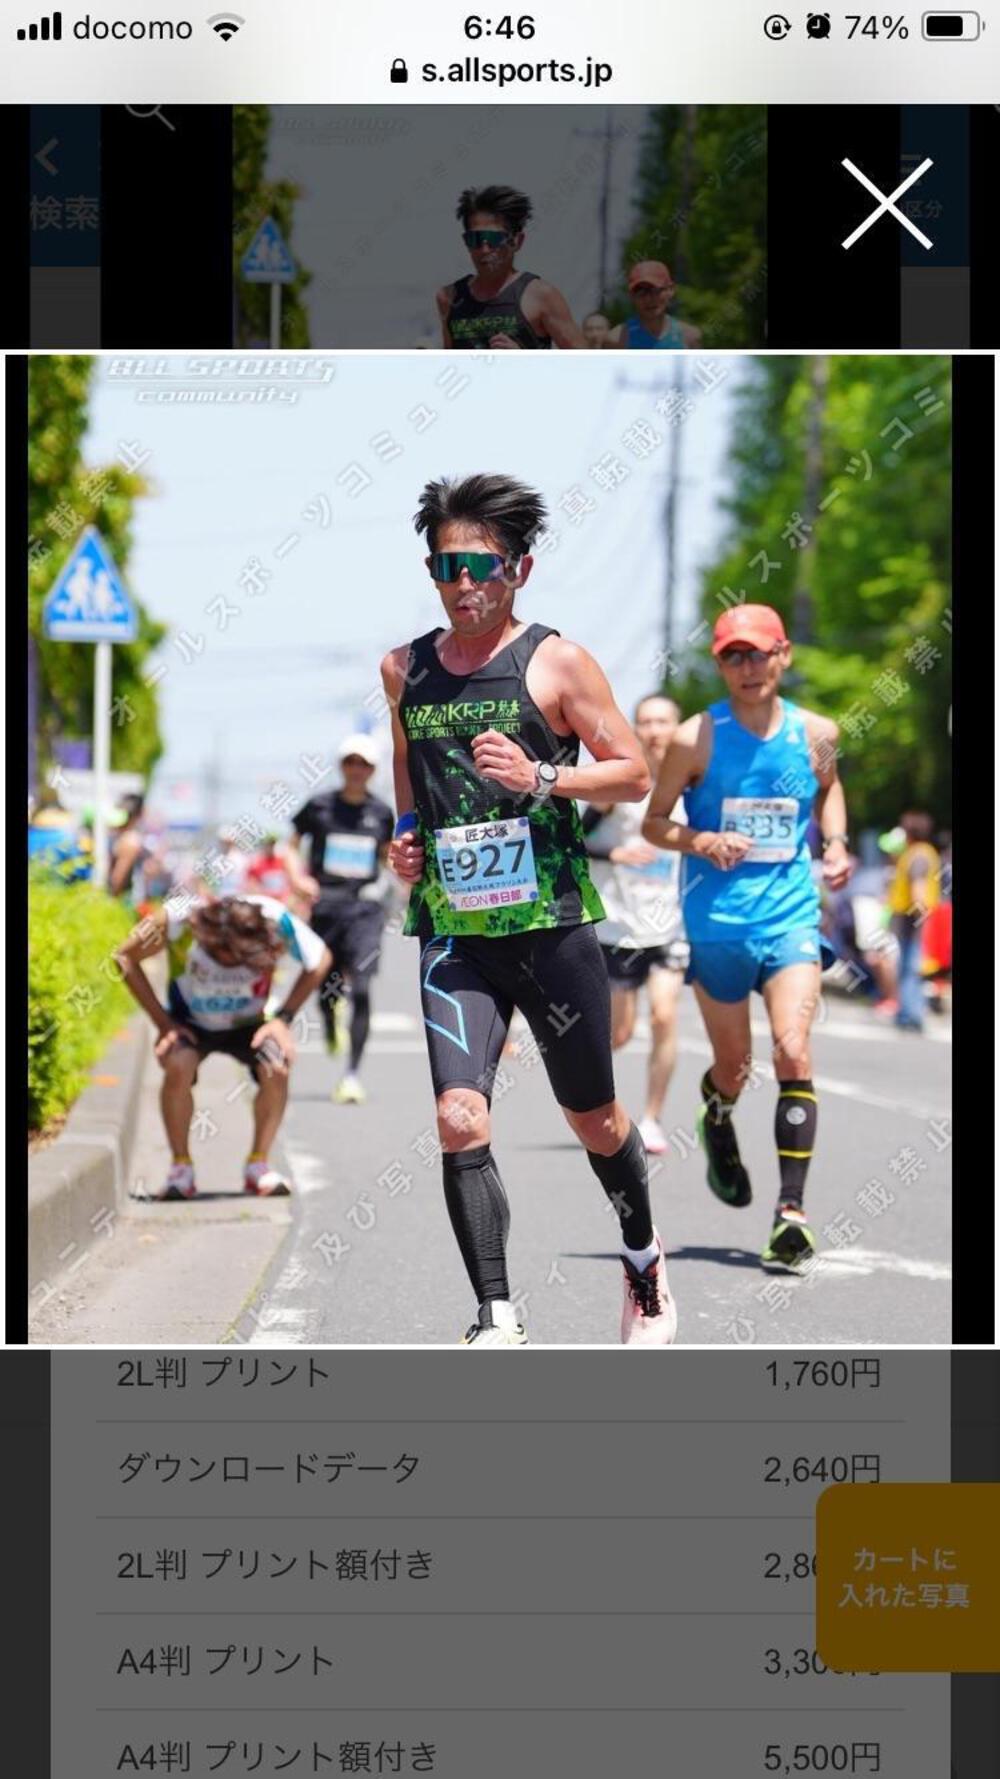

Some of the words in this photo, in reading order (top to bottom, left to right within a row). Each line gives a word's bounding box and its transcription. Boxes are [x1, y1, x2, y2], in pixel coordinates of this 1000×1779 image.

[73, 15, 193, 39] docomo
[464, 15, 536, 39] 6:46
[845, 15, 909, 39] 74%
[422, 56, 613, 87] s.allsports.jp
[30, 194, 99, 231] 検索
[448, 699, 496, 721] KRP
[465, 823, 509, 842] 匠大塚
[442, 839, 526, 882] E927
[117, 1356, 186, 1388] 2L判
[202, 1356, 329, 1388] プリント
[764, 1359, 881, 1390] 1,760円
[119, 1452, 420, 1484] ダウンロードデータ
[764, 1455, 881, 1483] 2,640円
[117, 1548, 186, 1581] 2L判
[202, 1548, 433, 1581] プリント額付き
[854, 1547, 957, 1572] カートに
[838, 1583, 971, 1609] 入れた写真
[117, 1644, 192, 1677] A4判
[206, 1644, 333, 1676] プリント
[117, 1740, 192, 1773] A4判
[206, 1740, 437, 1773] プリント額付き
[764, 1743, 881, 1774] 5,500円
